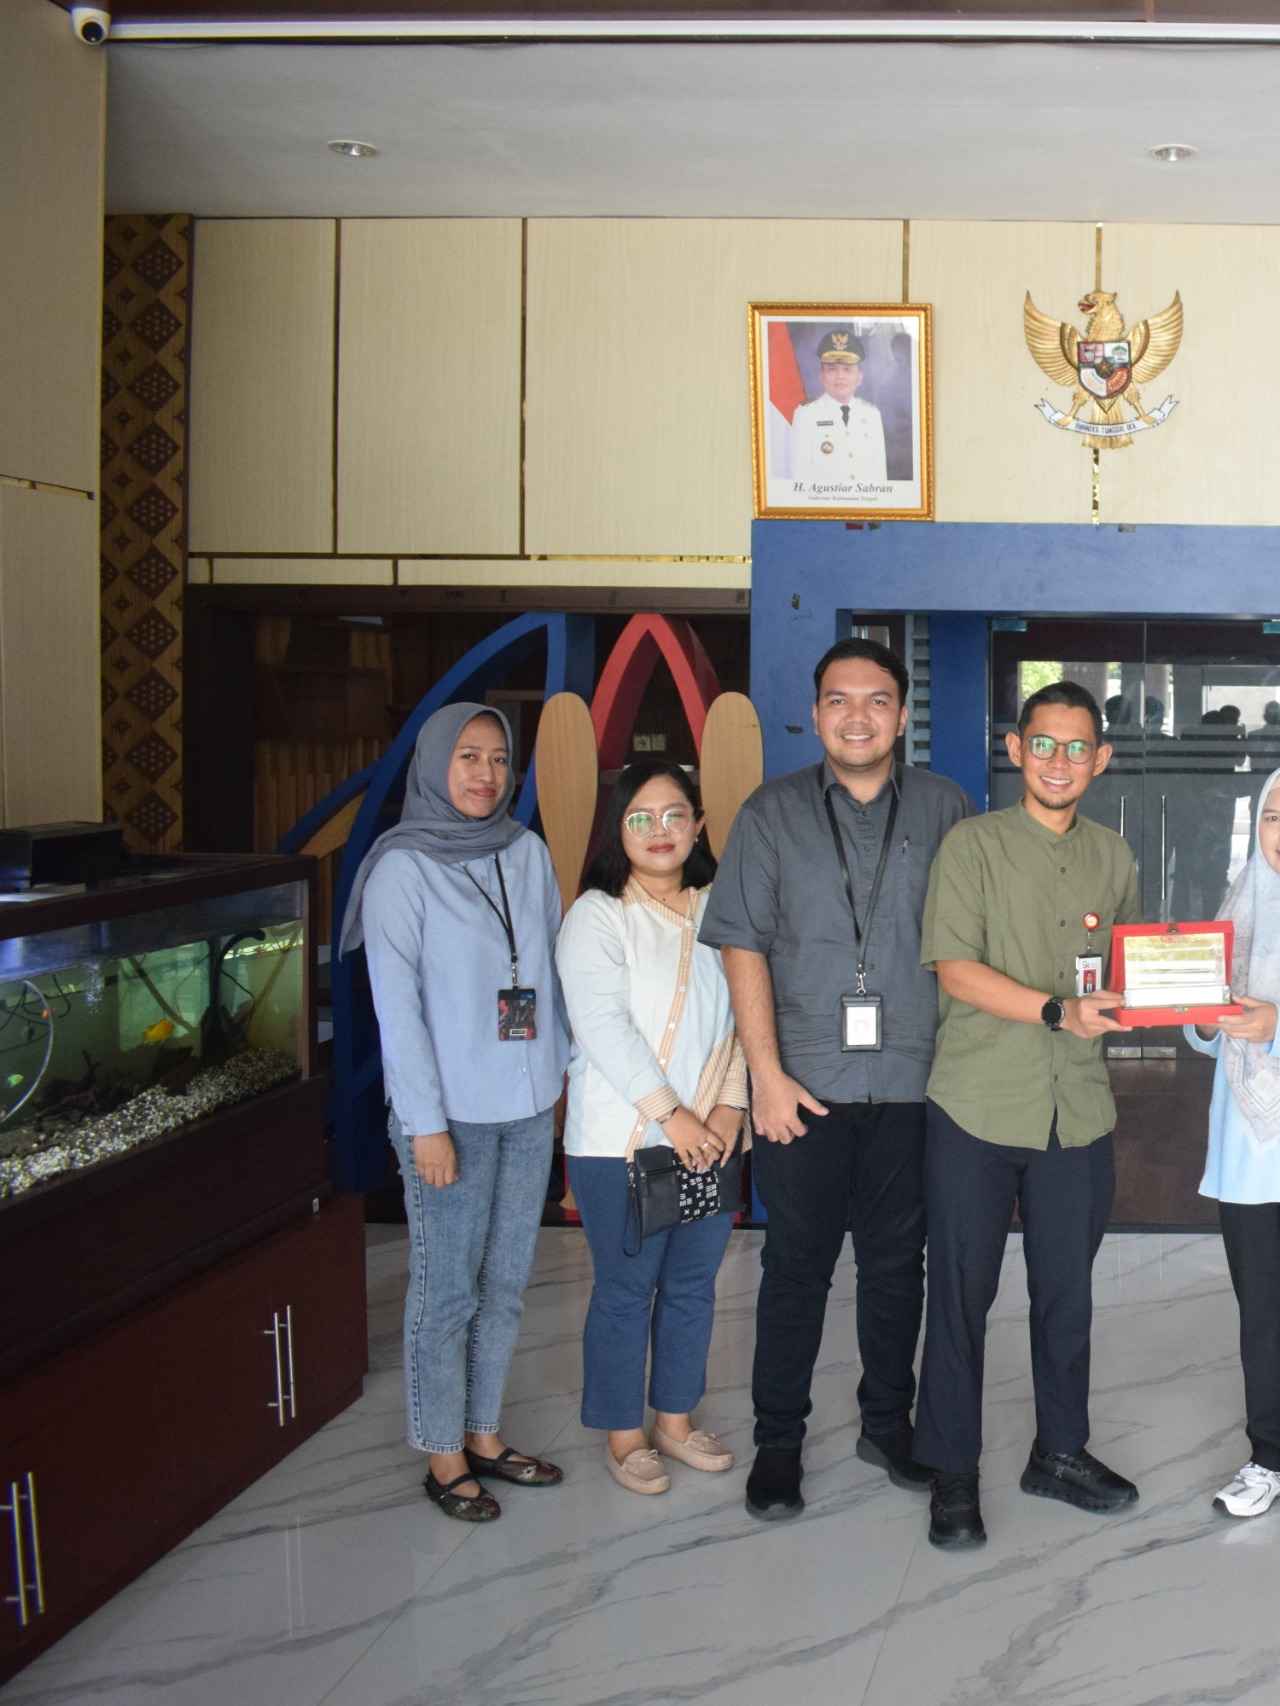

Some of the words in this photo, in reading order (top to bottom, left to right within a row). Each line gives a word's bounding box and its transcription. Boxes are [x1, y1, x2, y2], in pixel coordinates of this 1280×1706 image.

[794, 482, 806, 492] H.
[809, 482, 853, 494] Agustiar
[856, 482, 893, 493] Sabran
